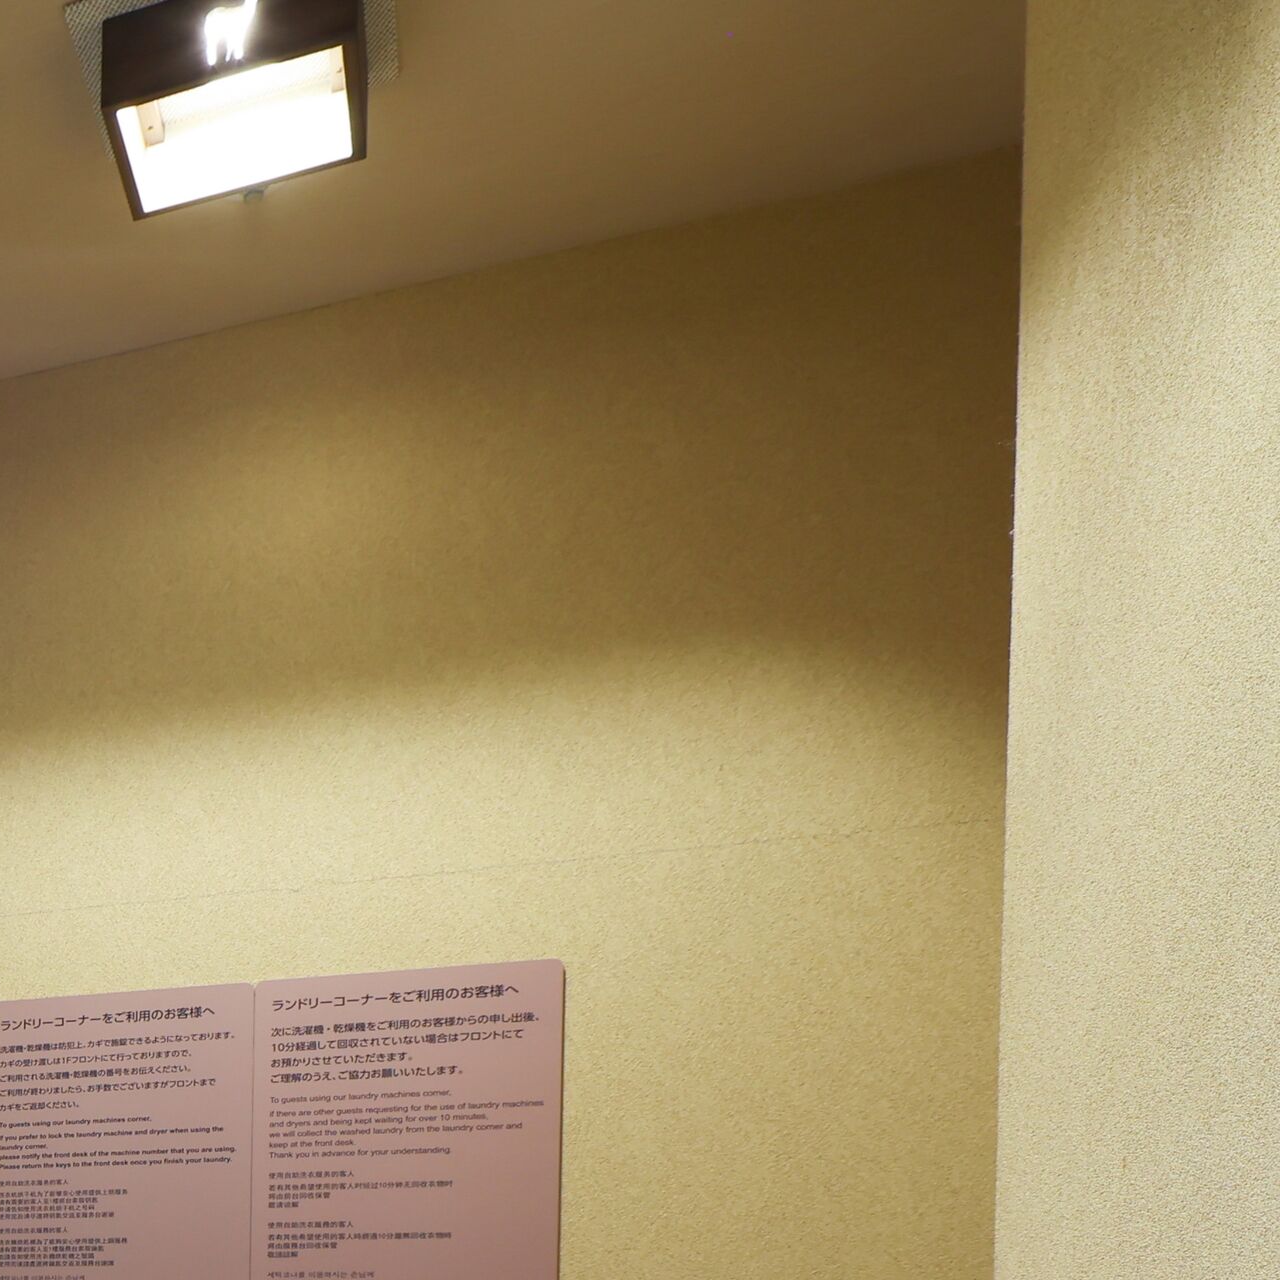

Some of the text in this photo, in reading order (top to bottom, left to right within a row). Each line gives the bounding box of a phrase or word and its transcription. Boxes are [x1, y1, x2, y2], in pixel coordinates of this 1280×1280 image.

[272, 984, 520, 1011] ランドリーコーナーをご利用のお客様へ
[0, 1006, 216, 1031] ランドリーコーナーをご利用のお客様へ
